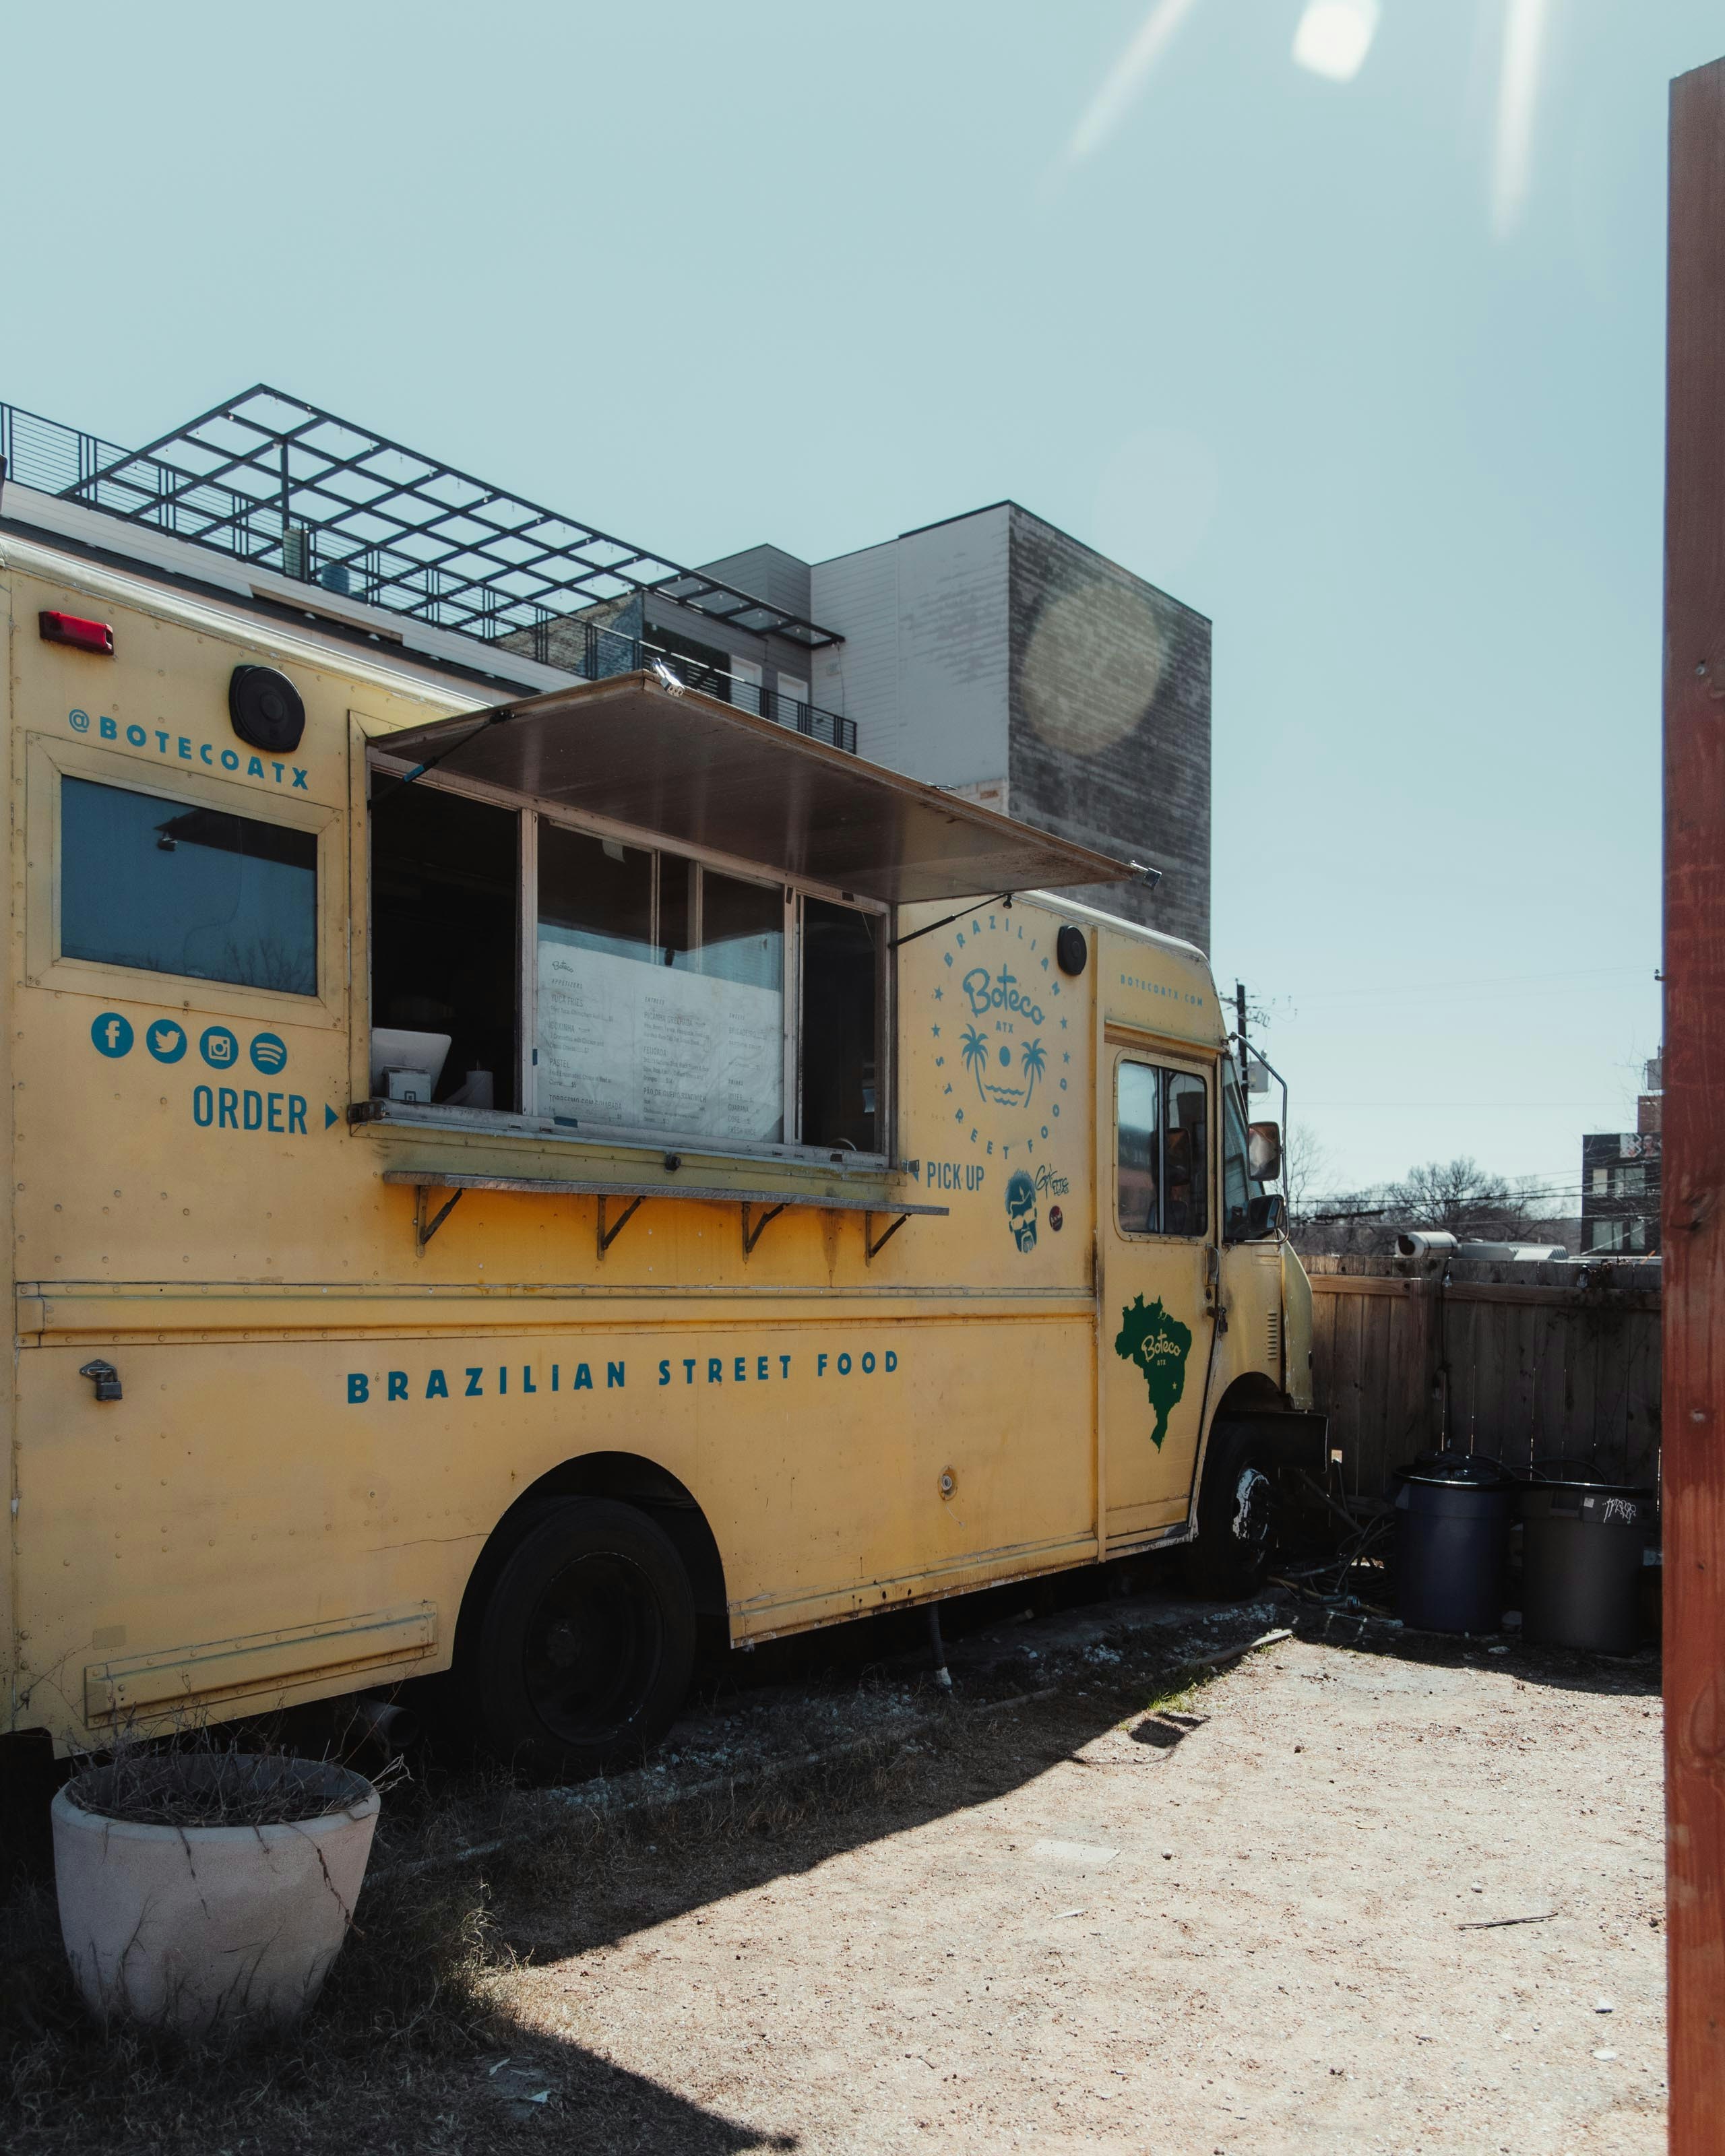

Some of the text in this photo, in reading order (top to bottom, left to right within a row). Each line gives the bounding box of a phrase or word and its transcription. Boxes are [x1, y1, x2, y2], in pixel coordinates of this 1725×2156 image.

[69, 709, 309, 790] @BOTECOATX
[551, 959, 574, 974] Boteco
[944, 915, 1060, 996] BRAZILIAN
[567, 996, 584, 1007] FRIES
[962, 963, 1045, 1025] Boteco
[995, 1020, 1014, 1034] ATX
[549, 1058, 570, 1068] PASTEL
[644, 1046, 667, 1056] FEIJOADA
[193, 1085, 307, 1135] ORDER
[936, 1056, 1067, 1160] STREET FOOD
[927, 1161, 985, 1191] PICK UP
[1141, 1328, 1181, 1362] Boteco
[346, 1351, 899, 1403] BRAZILIAN STREET FOOD
